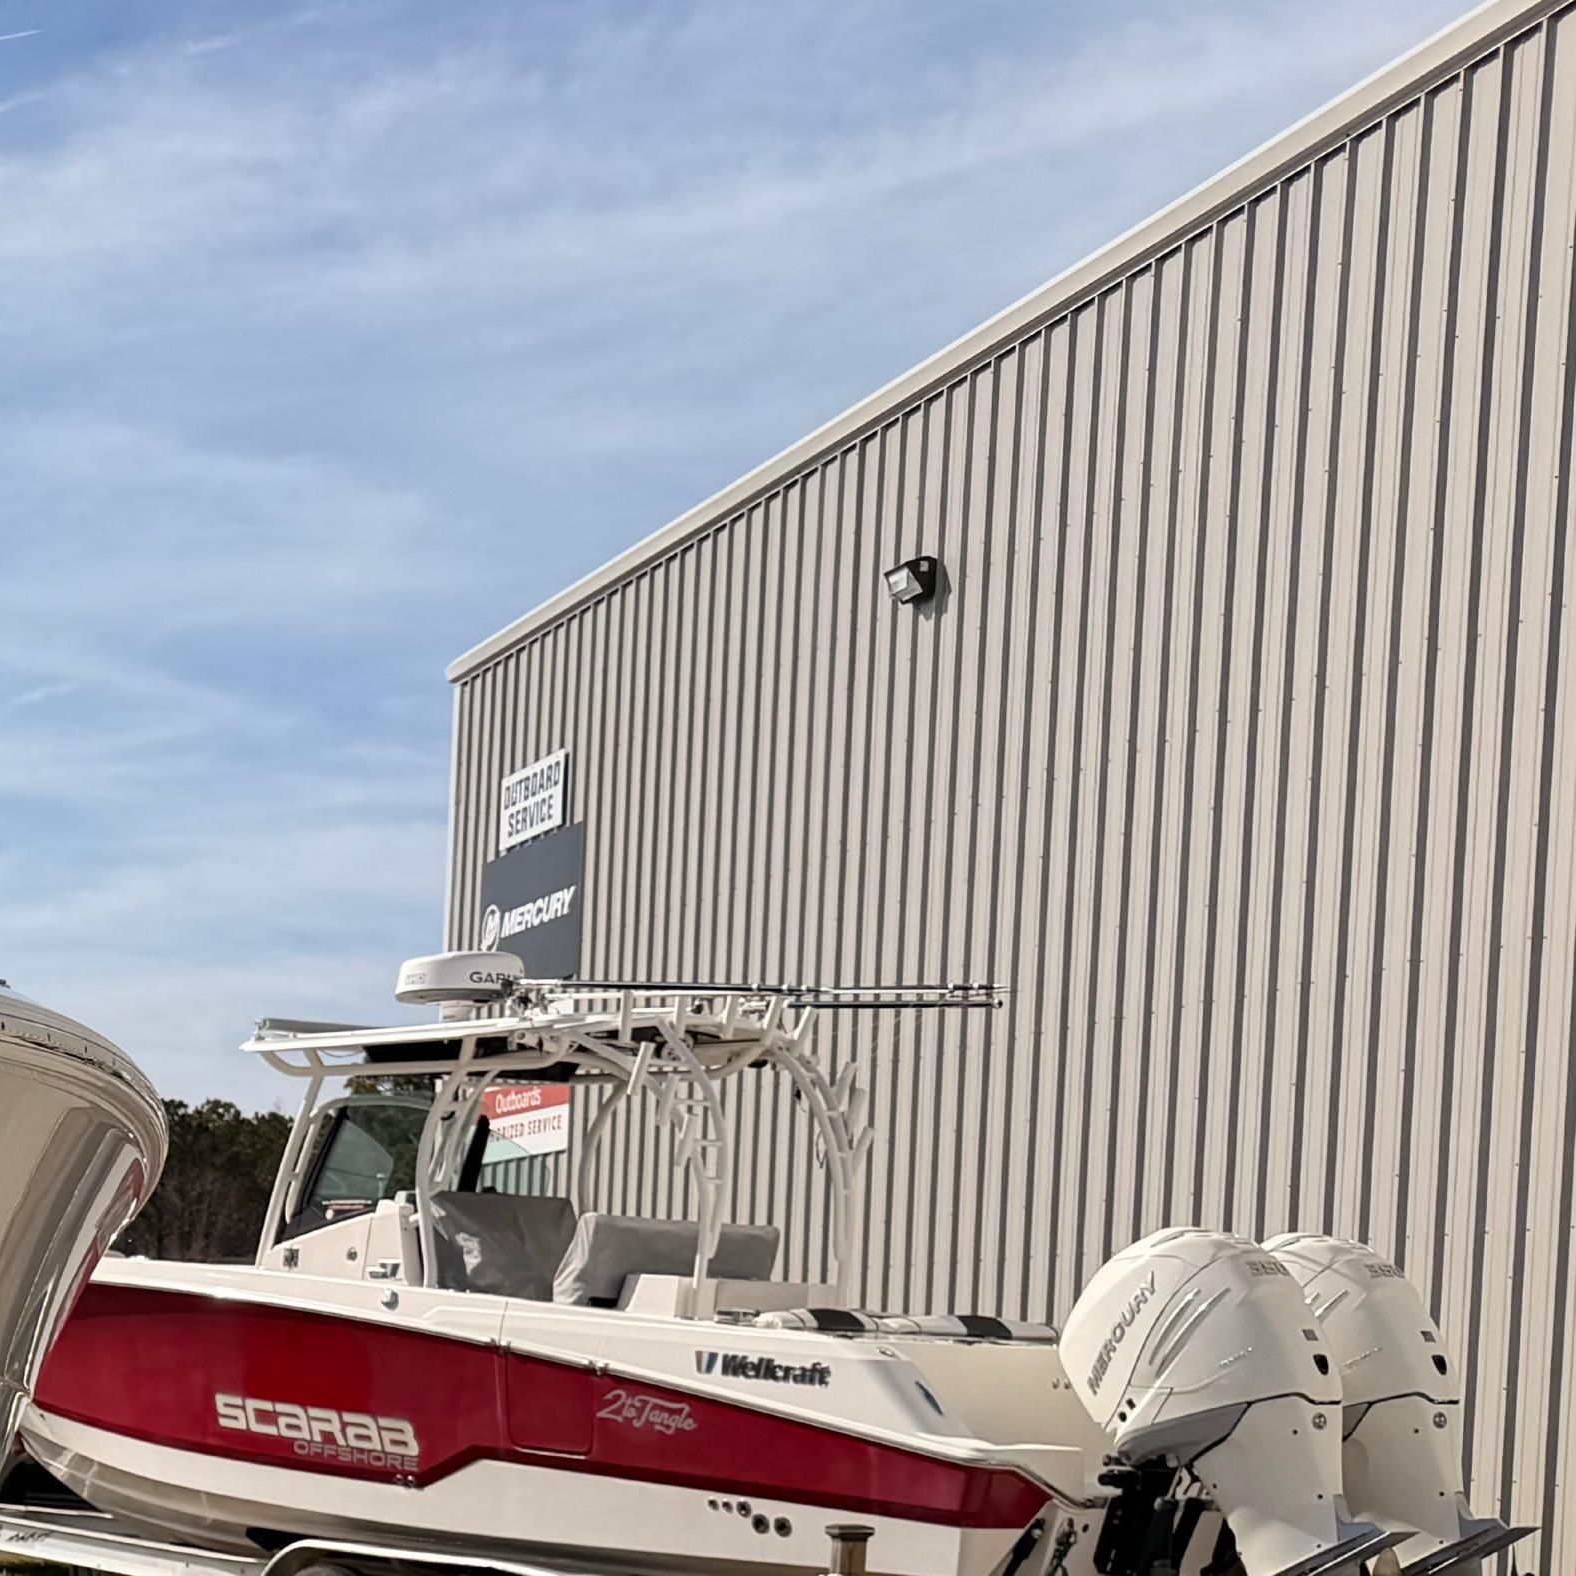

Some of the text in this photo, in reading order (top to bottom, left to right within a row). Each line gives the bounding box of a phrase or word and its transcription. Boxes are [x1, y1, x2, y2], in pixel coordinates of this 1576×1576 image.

[503, 760, 561, 811] OUTBOARD
[507, 794, 554, 838] SERVICE
[500, 885, 576, 939] MERCURY
[495, 1086, 542, 1114] Outboards
[527, 1114, 563, 1136] SERVICE
[1086, 1270, 1156, 1397] MERCURY
[720, 1353, 832, 1389] Wellcraft
[293, 1440, 420, 1472] OFFSHORE
